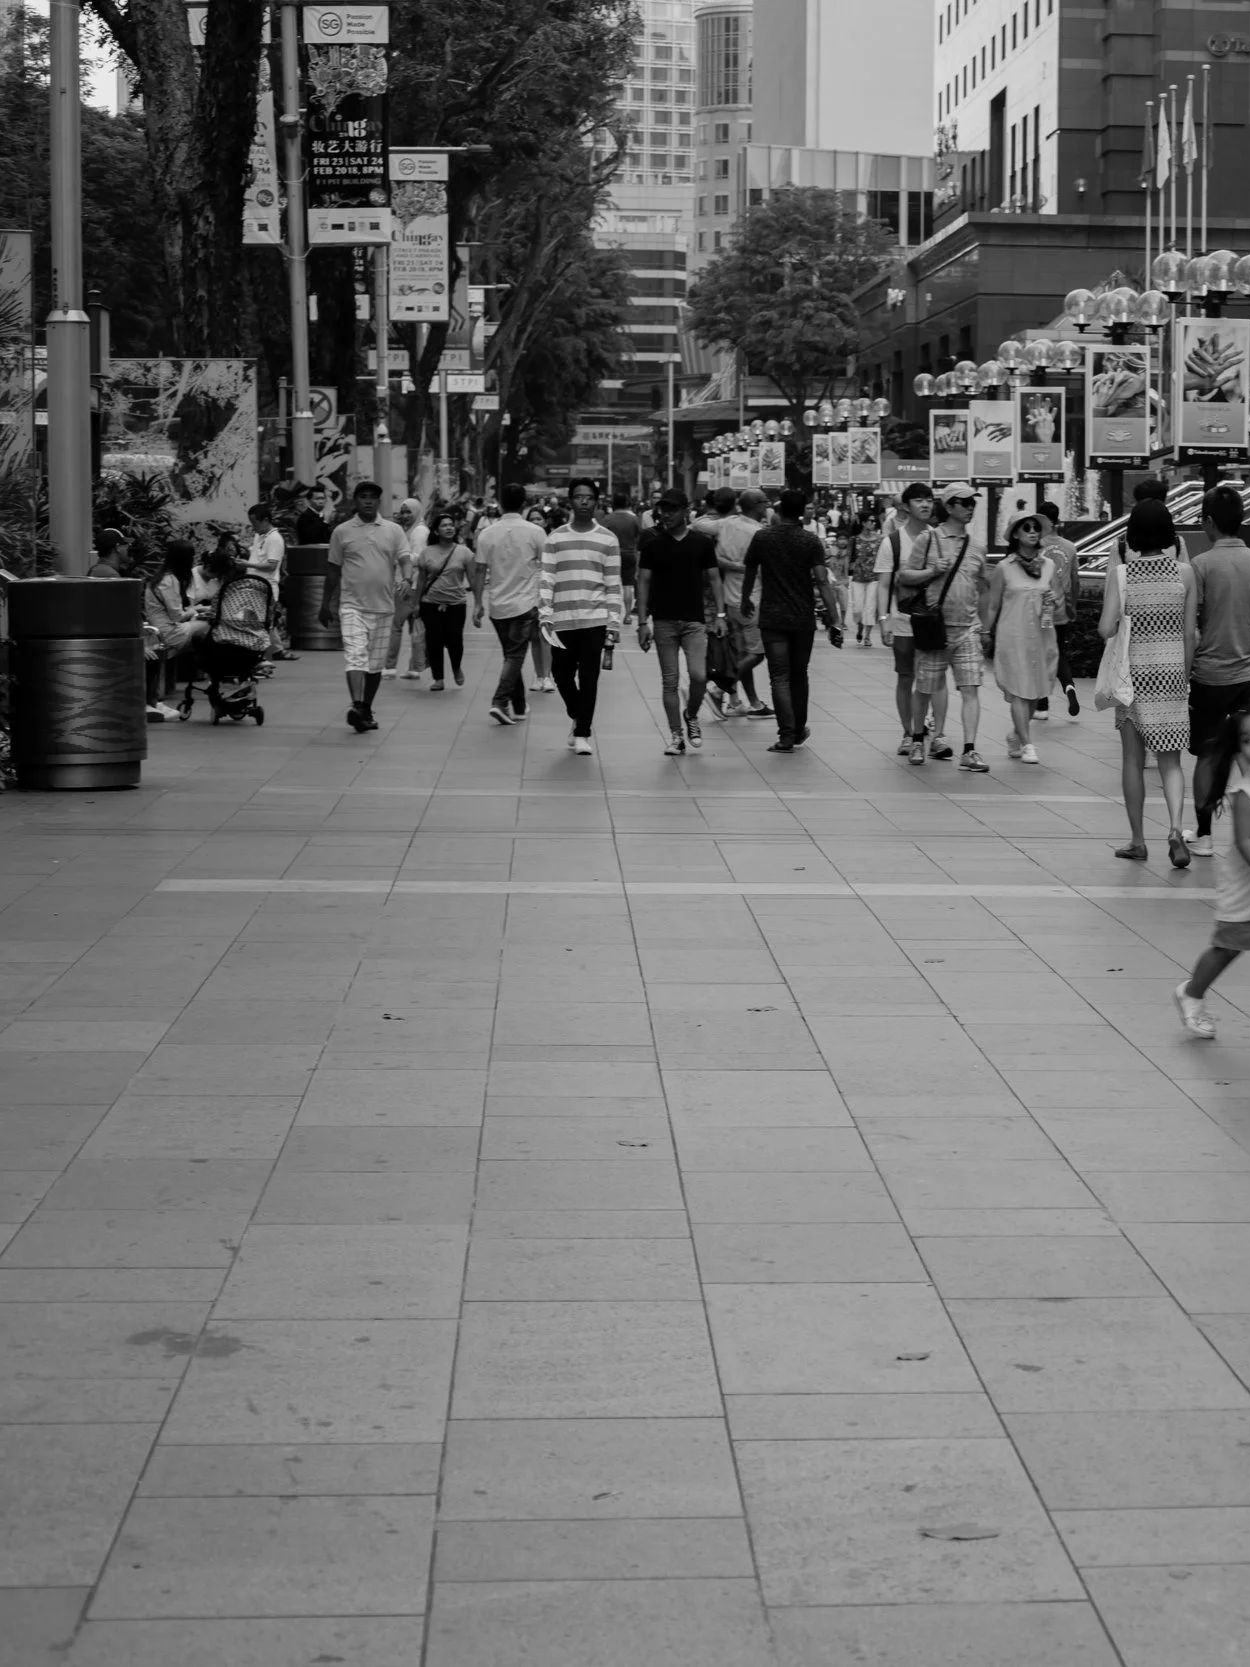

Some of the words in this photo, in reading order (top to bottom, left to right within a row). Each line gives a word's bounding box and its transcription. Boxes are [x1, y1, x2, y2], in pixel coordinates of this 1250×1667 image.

[321, 19, 339, 30] SG
[313, 157, 330, 166] FRI
[331, 157, 344, 166] 23
[350, 156, 369, 165] SAT
[370, 156, 383, 165] 24
[313, 166, 333, 175] FEB
[334, 166, 361, 175] 2018,
[362, 166, 384, 174] 8PM
